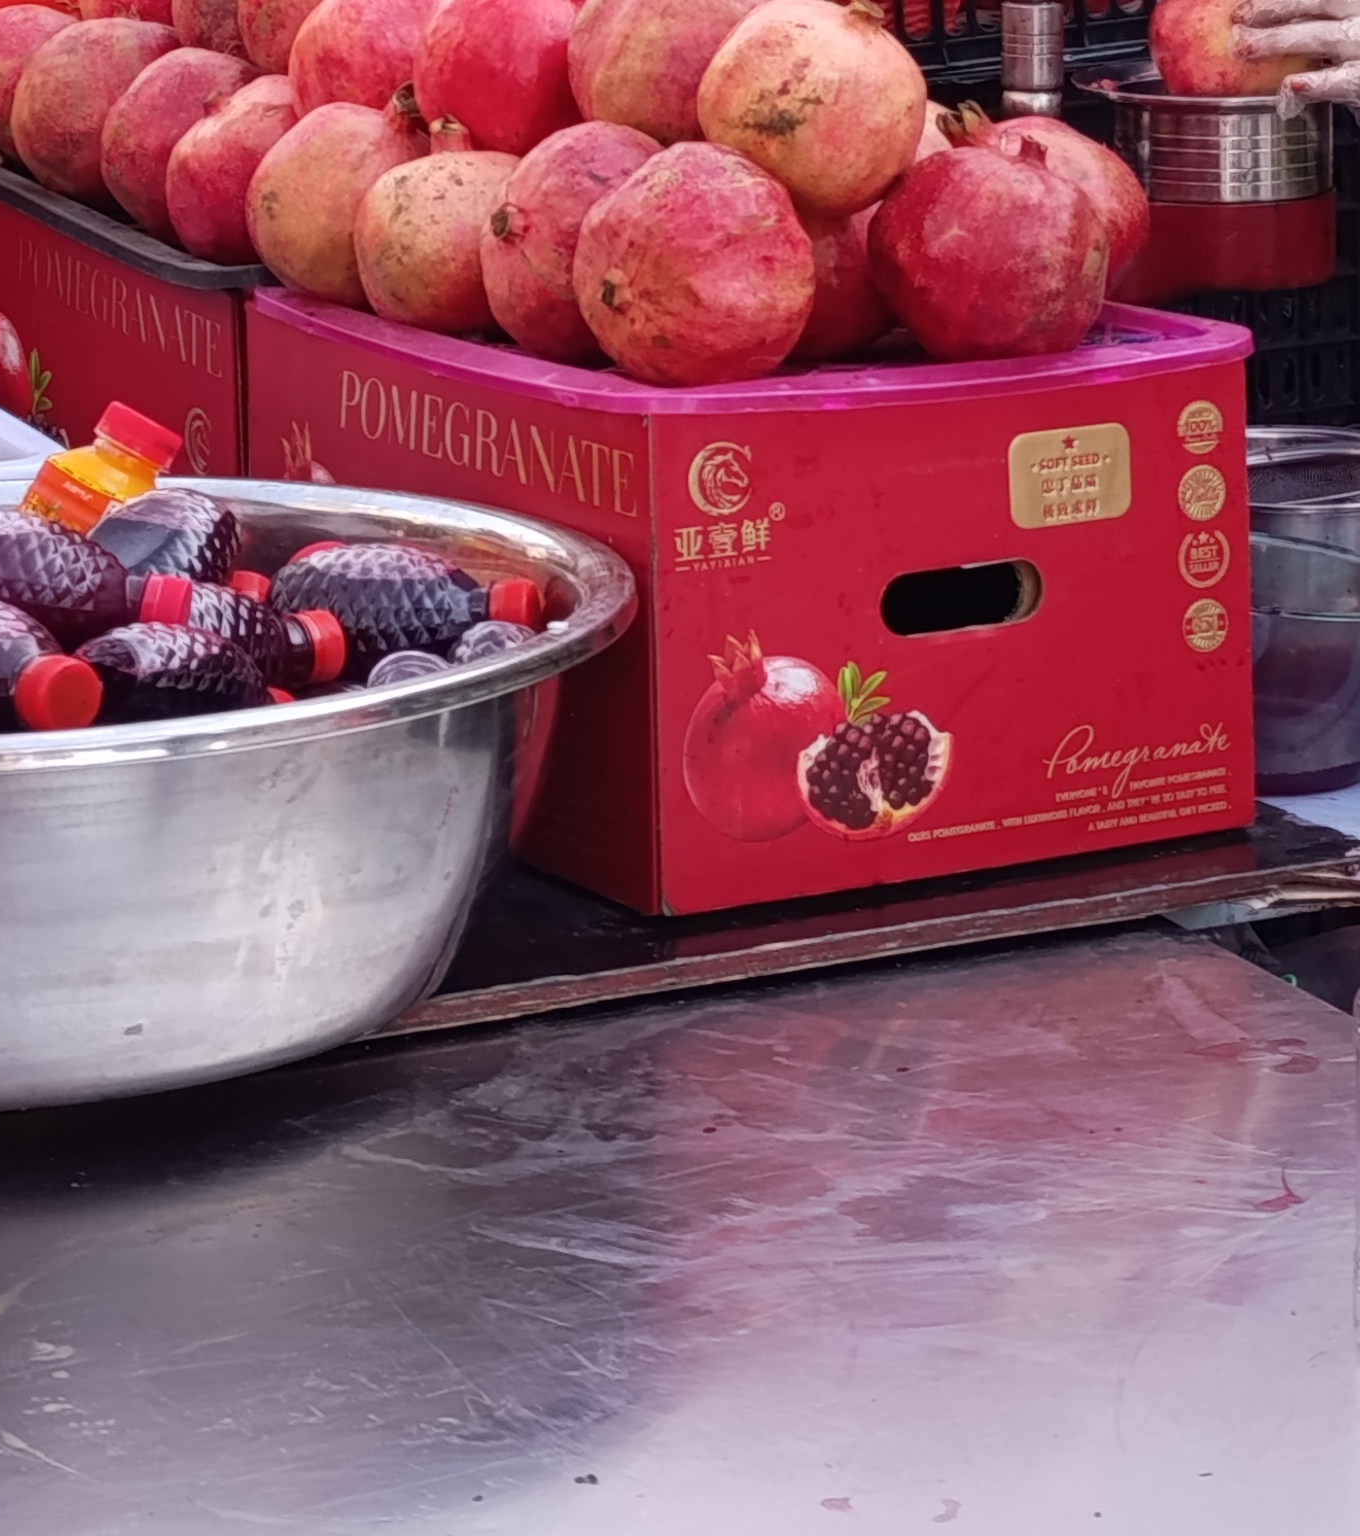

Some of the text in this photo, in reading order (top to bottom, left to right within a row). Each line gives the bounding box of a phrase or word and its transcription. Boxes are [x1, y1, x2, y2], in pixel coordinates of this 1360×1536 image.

[16, 234, 224, 380] POMEGRANATE
[339, 369, 639, 519] POMEGRANATE
[1039, 452, 1101, 472] SOFT SEED
[673, 517, 772, 562] 亚壹鲜
[692, 555, 756, 572] YAYIXIAN
[1190, 547, 1218, 561] BEST
[1042, 722, 1232, 798] Pomegranate
[1106, 800, 1126, 812] AND
[1119, 815, 1138, 827] AND
